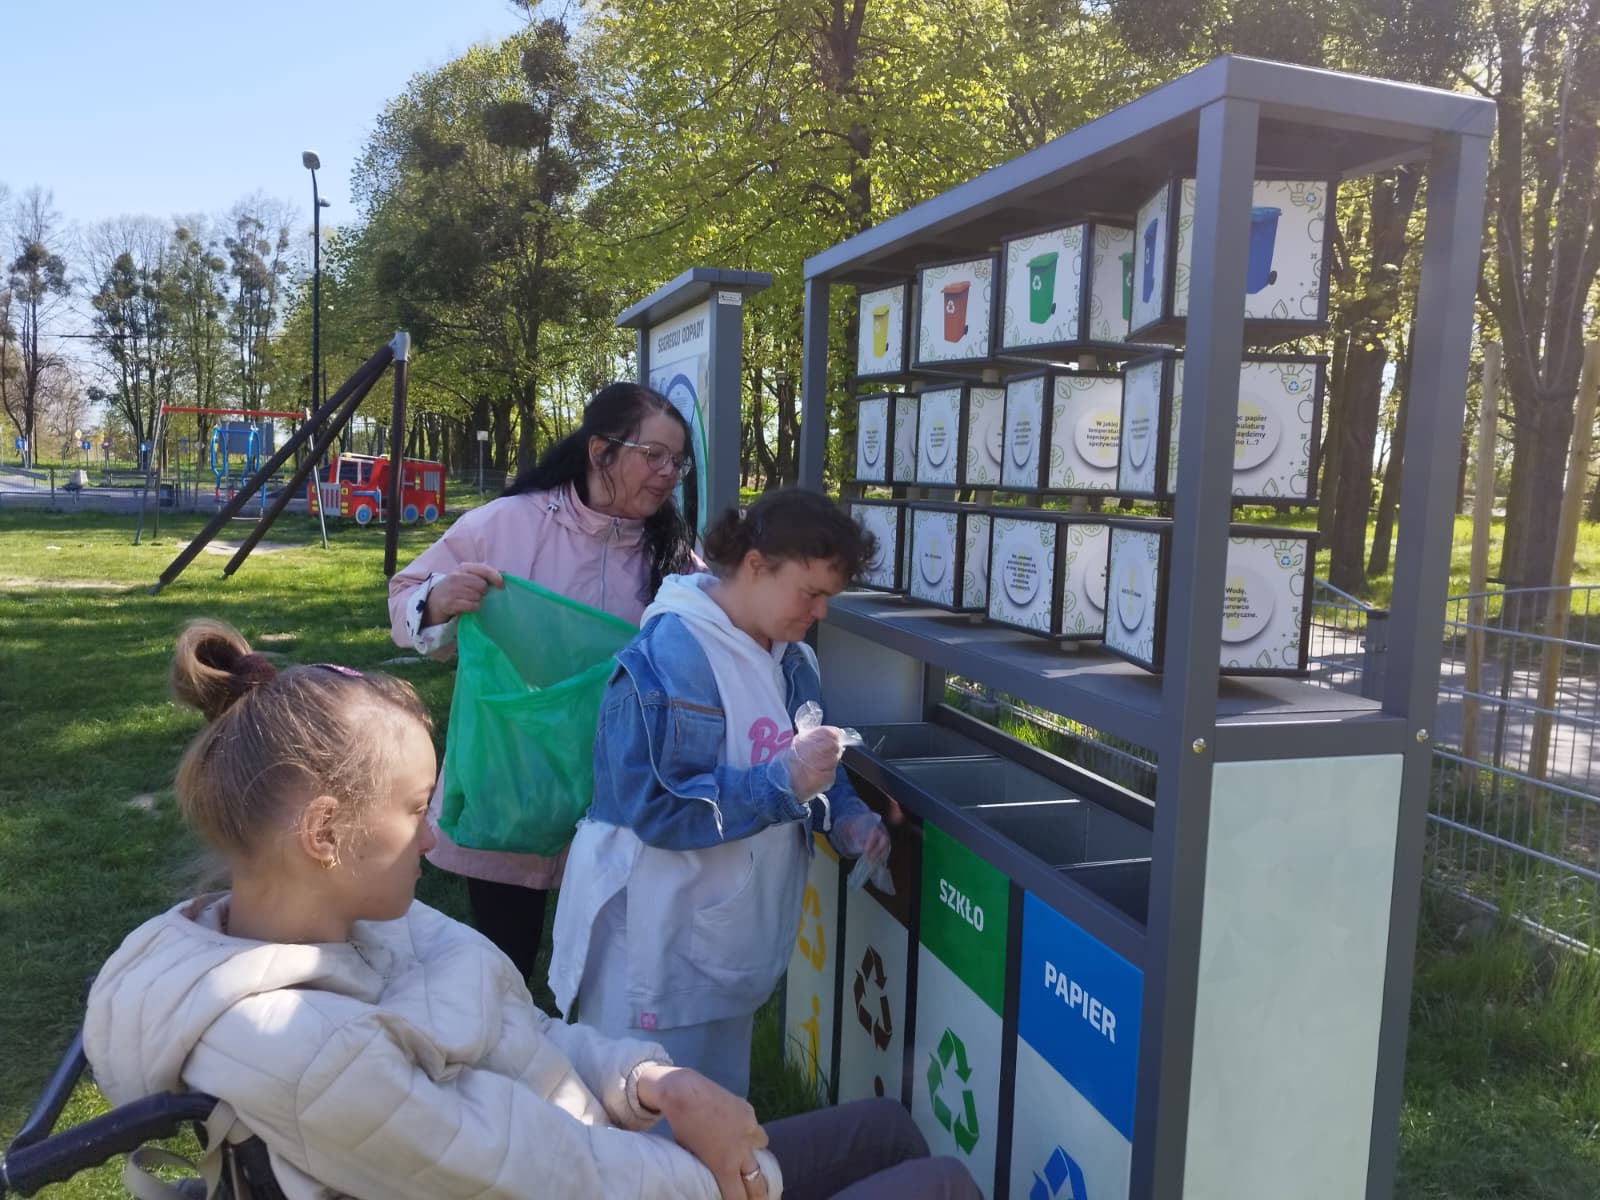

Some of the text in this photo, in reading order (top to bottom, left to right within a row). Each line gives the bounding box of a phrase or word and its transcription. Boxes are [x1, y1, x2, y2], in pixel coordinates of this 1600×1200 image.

[682, 319, 704, 344] ODPADY
[1235, 423, 1265, 431] kulaturę
[1237, 431, 1266, 439] zędzimy
[938, 877, 984, 933] SZKŁO
[1043, 959, 1117, 1045] PAPIER
